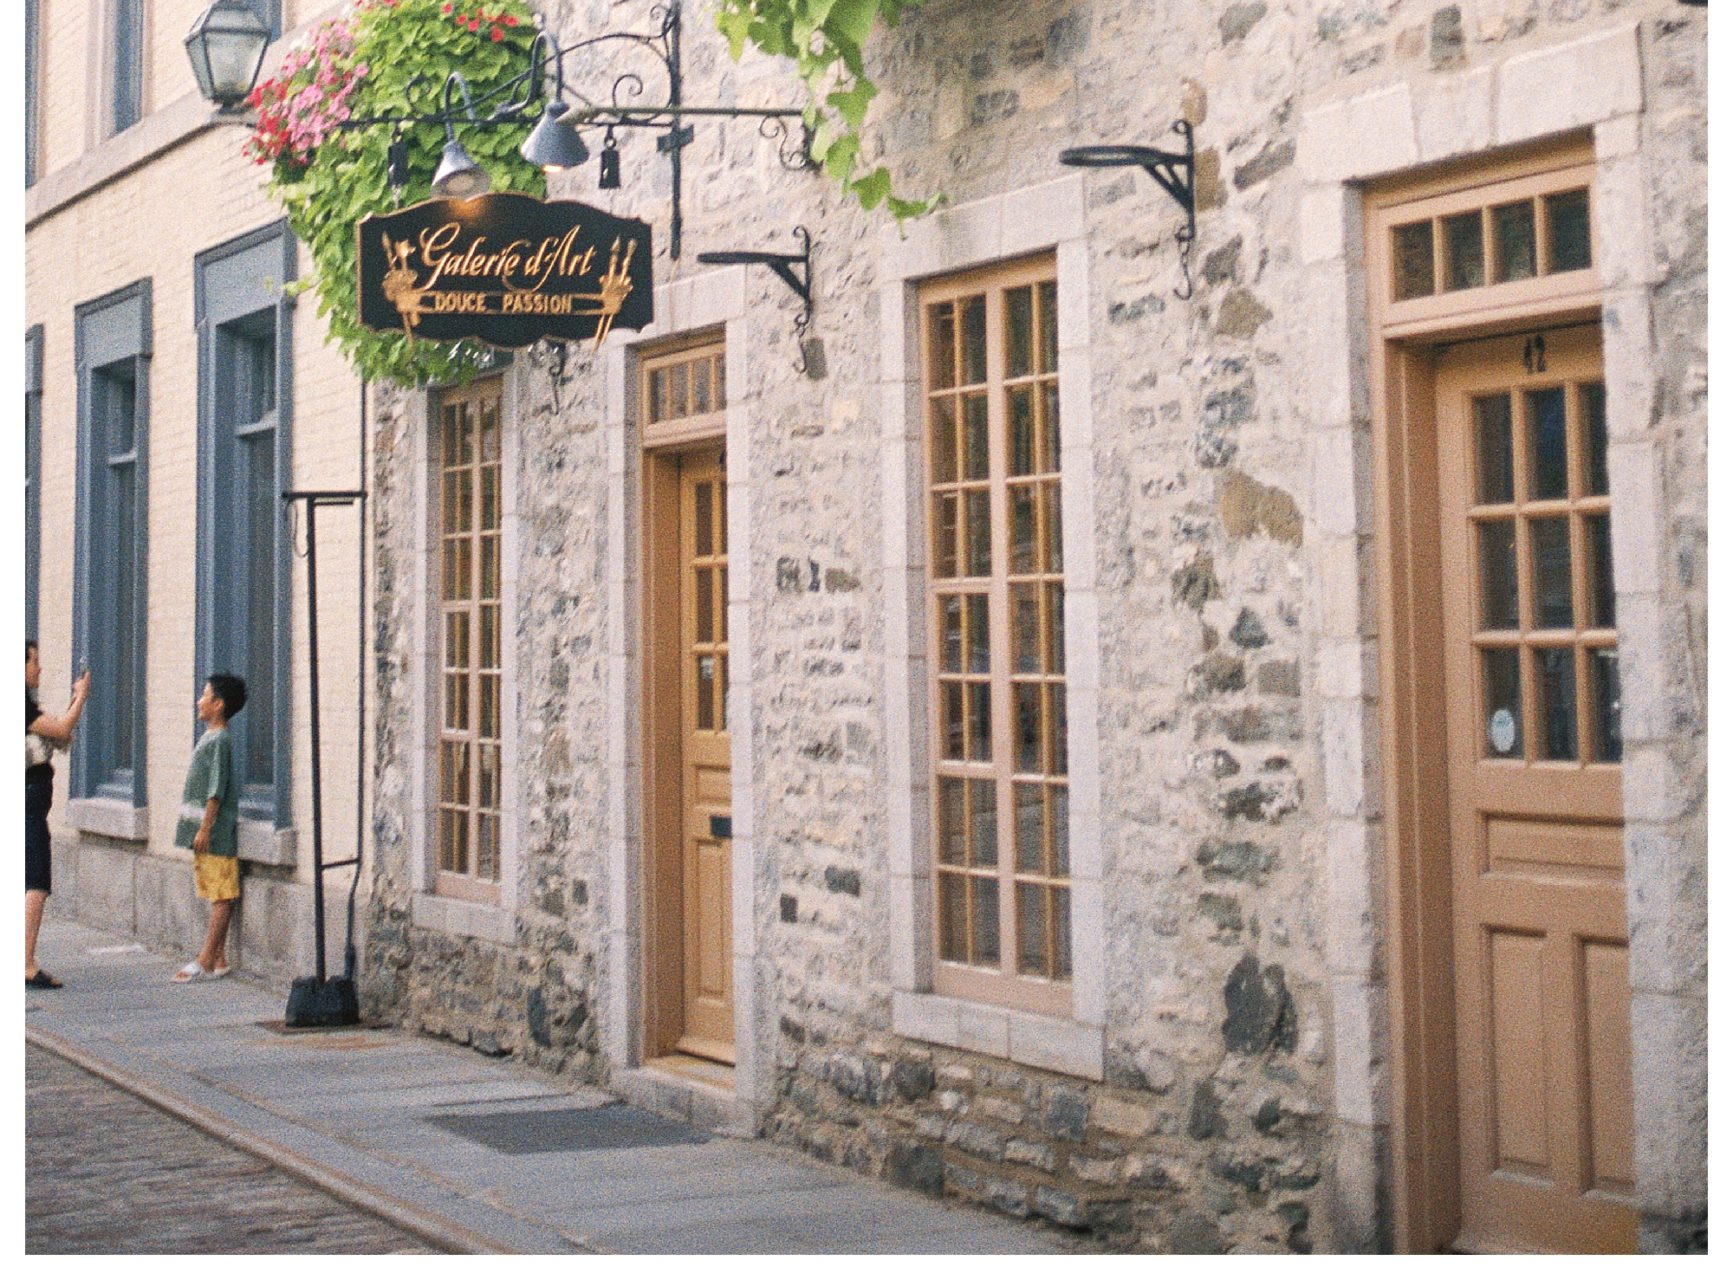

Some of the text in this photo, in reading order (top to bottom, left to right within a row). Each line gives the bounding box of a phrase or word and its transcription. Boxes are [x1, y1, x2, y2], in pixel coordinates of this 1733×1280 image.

[419, 222, 598, 292] Galerie d'Art
[434, 293, 573, 315] DOUCE PASSION
